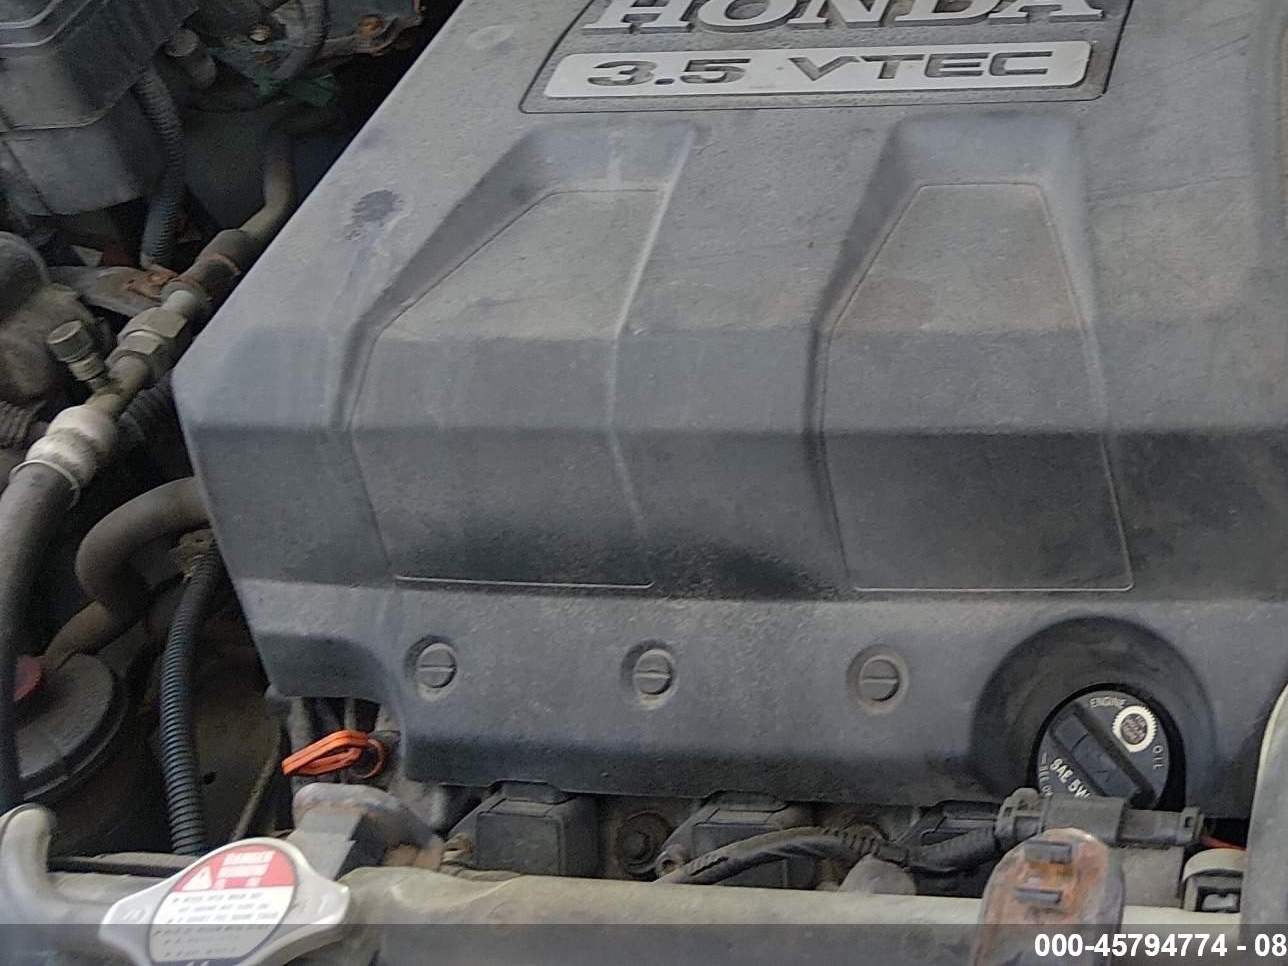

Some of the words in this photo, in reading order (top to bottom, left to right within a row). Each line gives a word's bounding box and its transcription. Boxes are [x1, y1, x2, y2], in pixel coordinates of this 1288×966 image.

[586, 57, 752, 87] 3.5
[789, 50, 1055, 81] VTEC
[1090, 696, 1127, 708] ENGINE
[1152, 745, 1164, 771] OIL
[1050, 758, 1073, 784] SAE
